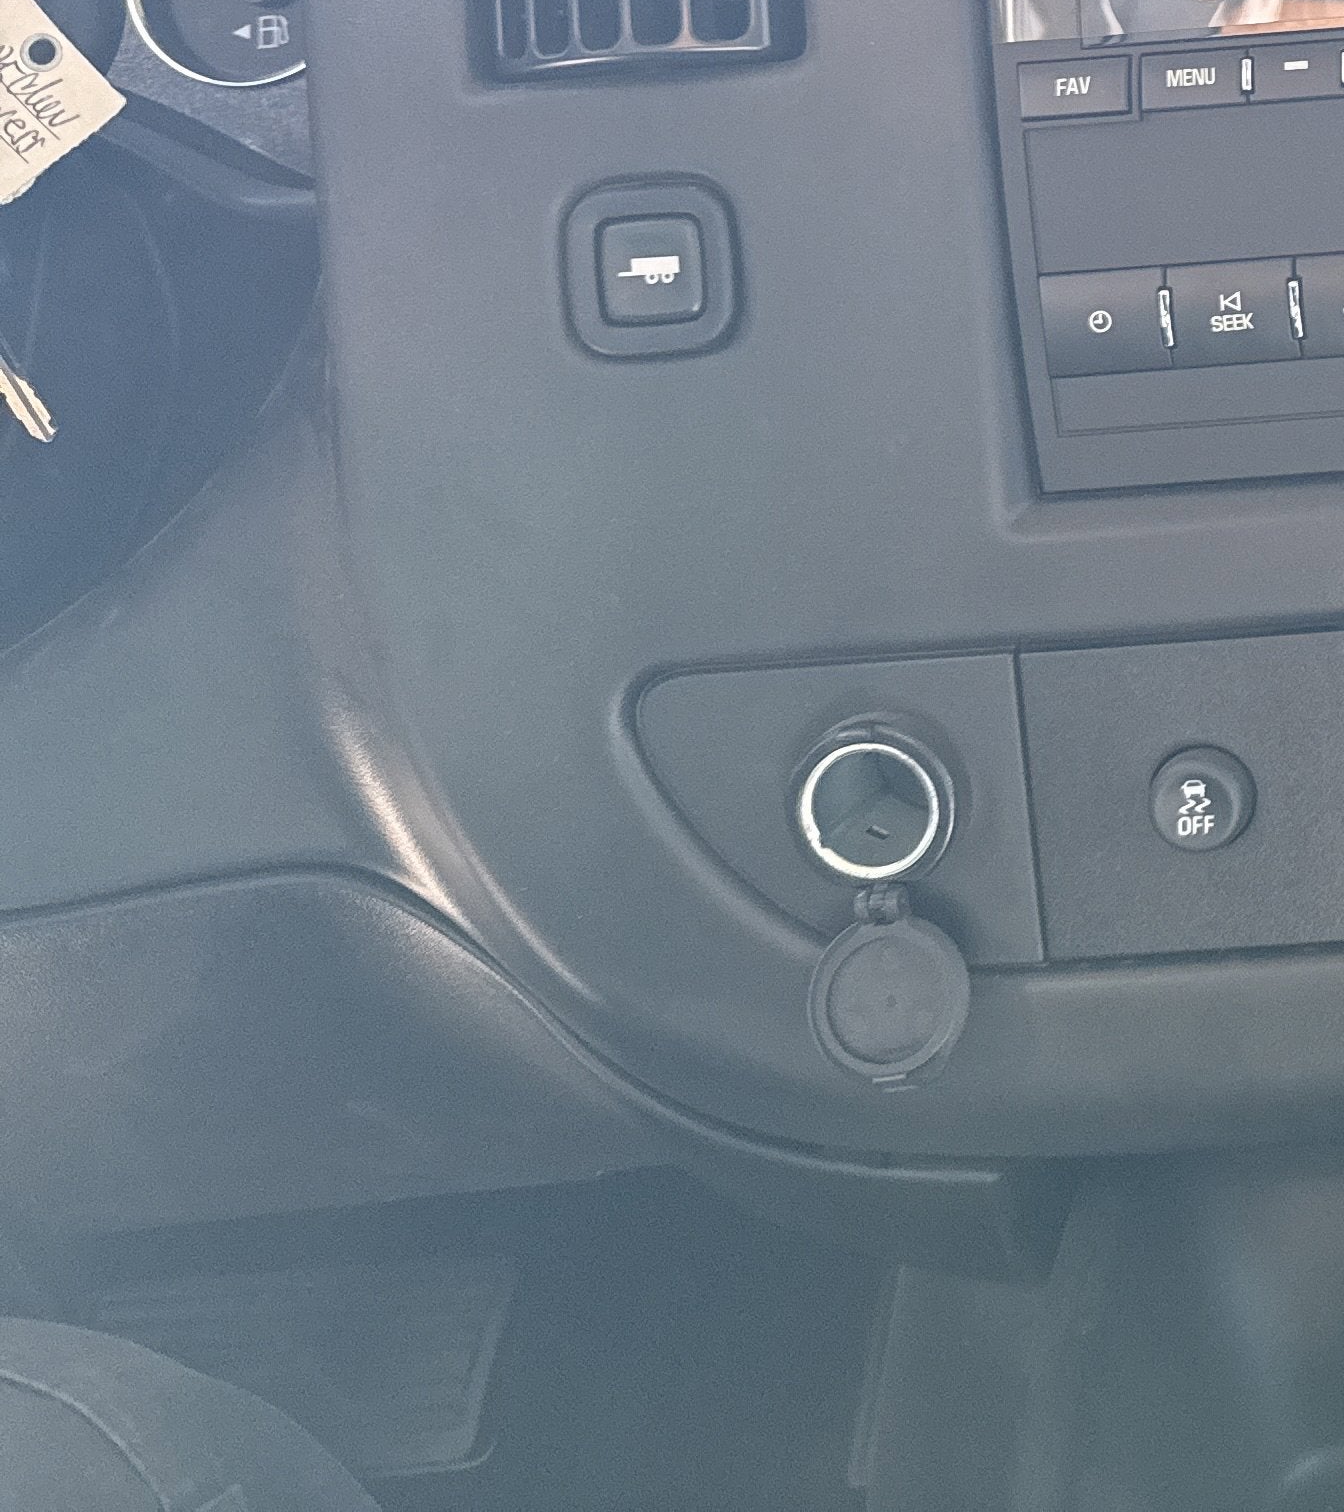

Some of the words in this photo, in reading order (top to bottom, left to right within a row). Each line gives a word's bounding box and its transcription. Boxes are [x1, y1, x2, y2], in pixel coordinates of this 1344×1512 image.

[1055, 76, 1091, 96] FAV
[1166, 67, 1216, 87] MENU
[1210, 312, 1255, 333] SEEK
[1177, 814, 1215, 836] OFF
